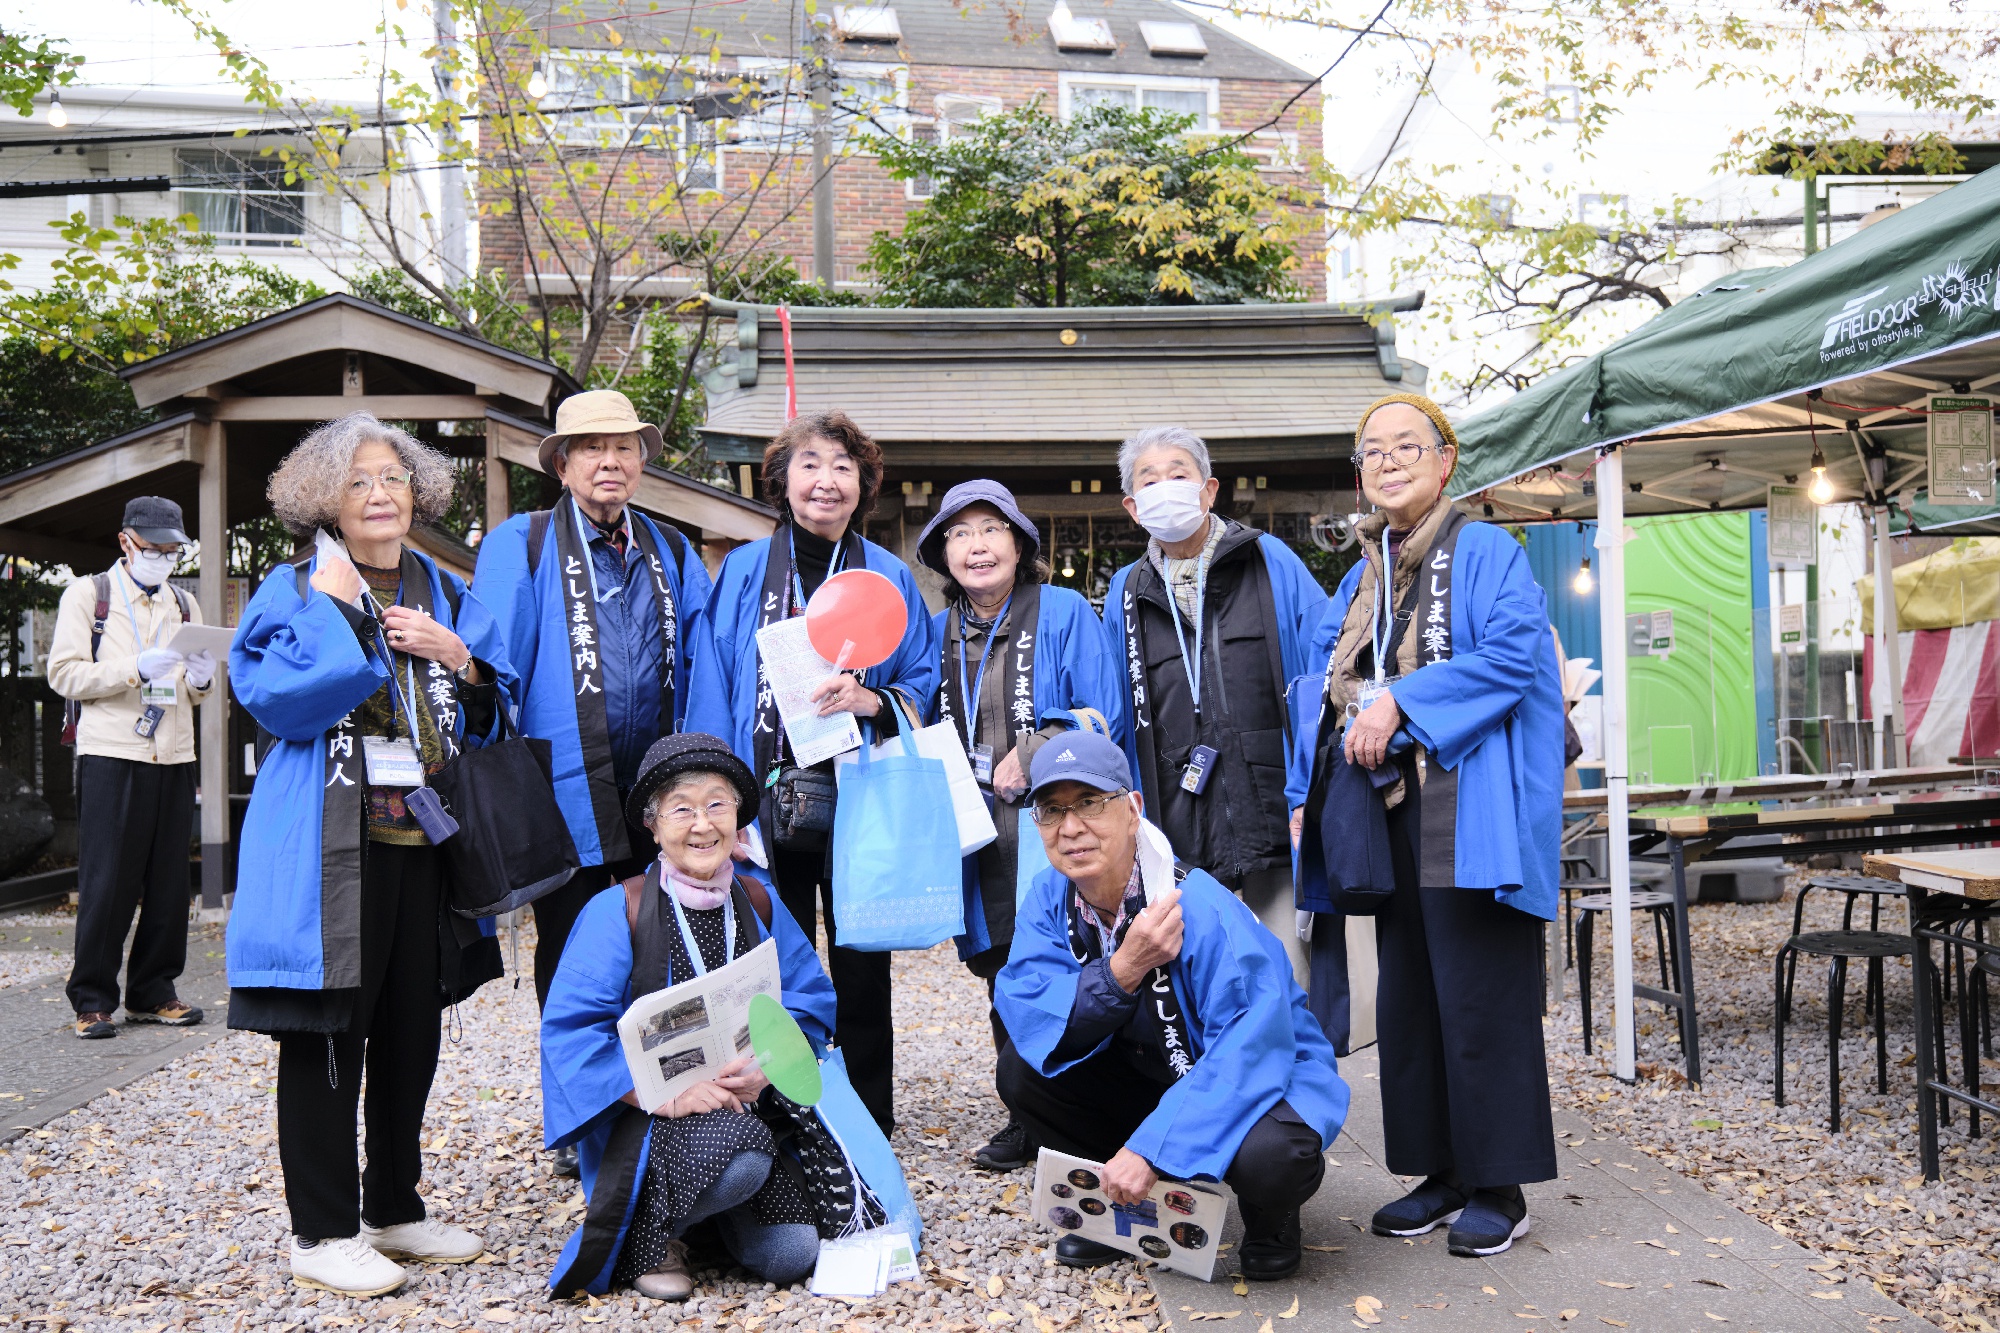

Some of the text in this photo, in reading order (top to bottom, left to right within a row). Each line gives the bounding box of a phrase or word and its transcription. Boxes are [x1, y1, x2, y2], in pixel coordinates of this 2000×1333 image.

[1820, 322, 1924, 364] Powered by ottostyle.jp
[1840, 295, 1919, 342] FIELDOOR
[1918, 288, 1944, 306] SUN
[566, 555, 601, 696] としま案内人
[650, 553, 677, 690] としま案内人
[1124, 590, 1150, 732] としま案内人
